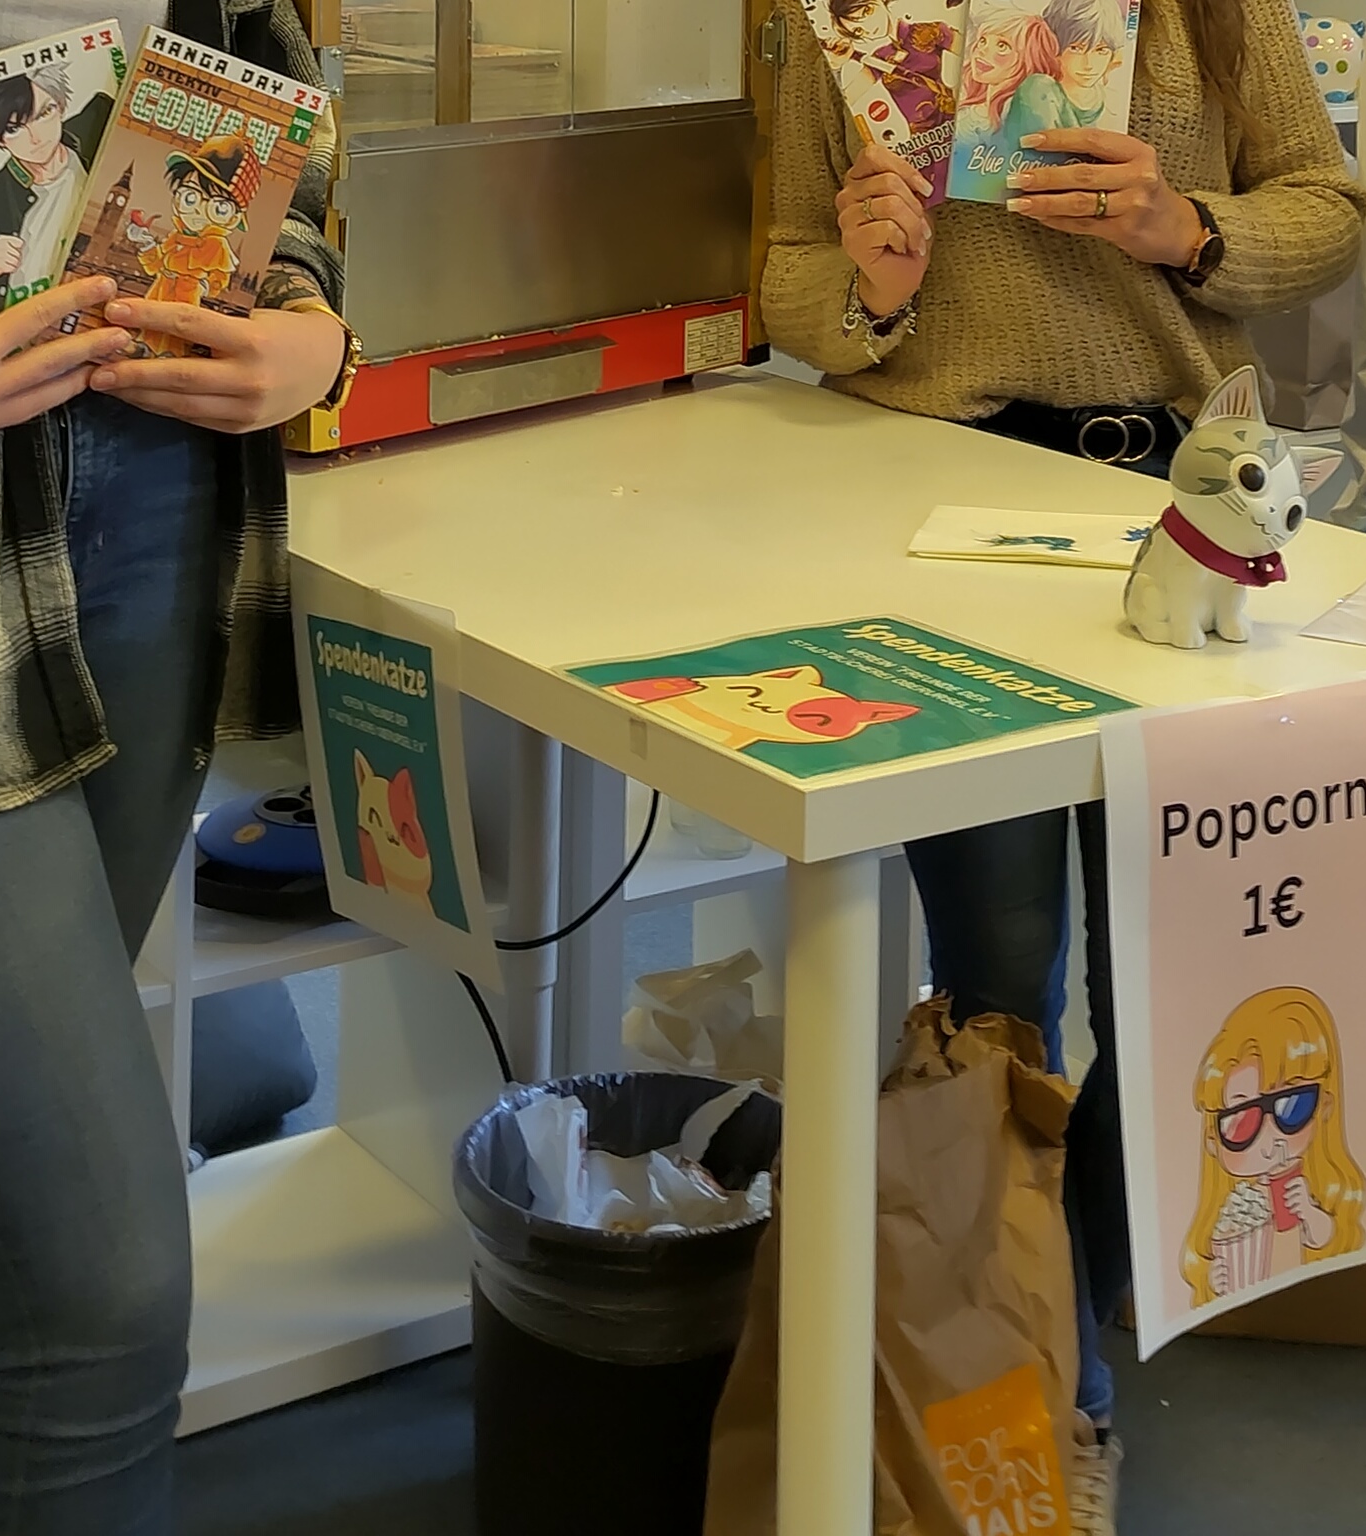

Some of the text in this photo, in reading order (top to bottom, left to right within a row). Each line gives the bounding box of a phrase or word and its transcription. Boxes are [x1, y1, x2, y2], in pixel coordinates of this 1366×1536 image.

[22, 43, 68, 68] DAY
[81, 30, 114, 51] 23
[152, 34, 229, 75] MANGA
[241, 69, 284, 94] DAY
[294, 88, 322, 110] 23
[144, 60, 223, 98] DETEKTIV
[130, 78, 281, 165] CONAN
[888, 120, 956, 155] chattenpri
[932, 142, 953, 161] Dra
[967, 145, 1059, 176] Blue Sprin
[316, 630, 428, 699] Spendenkatze
[841, 623, 1098, 713] Spendenkatze
[1241, 875, 1306, 938] 1€
